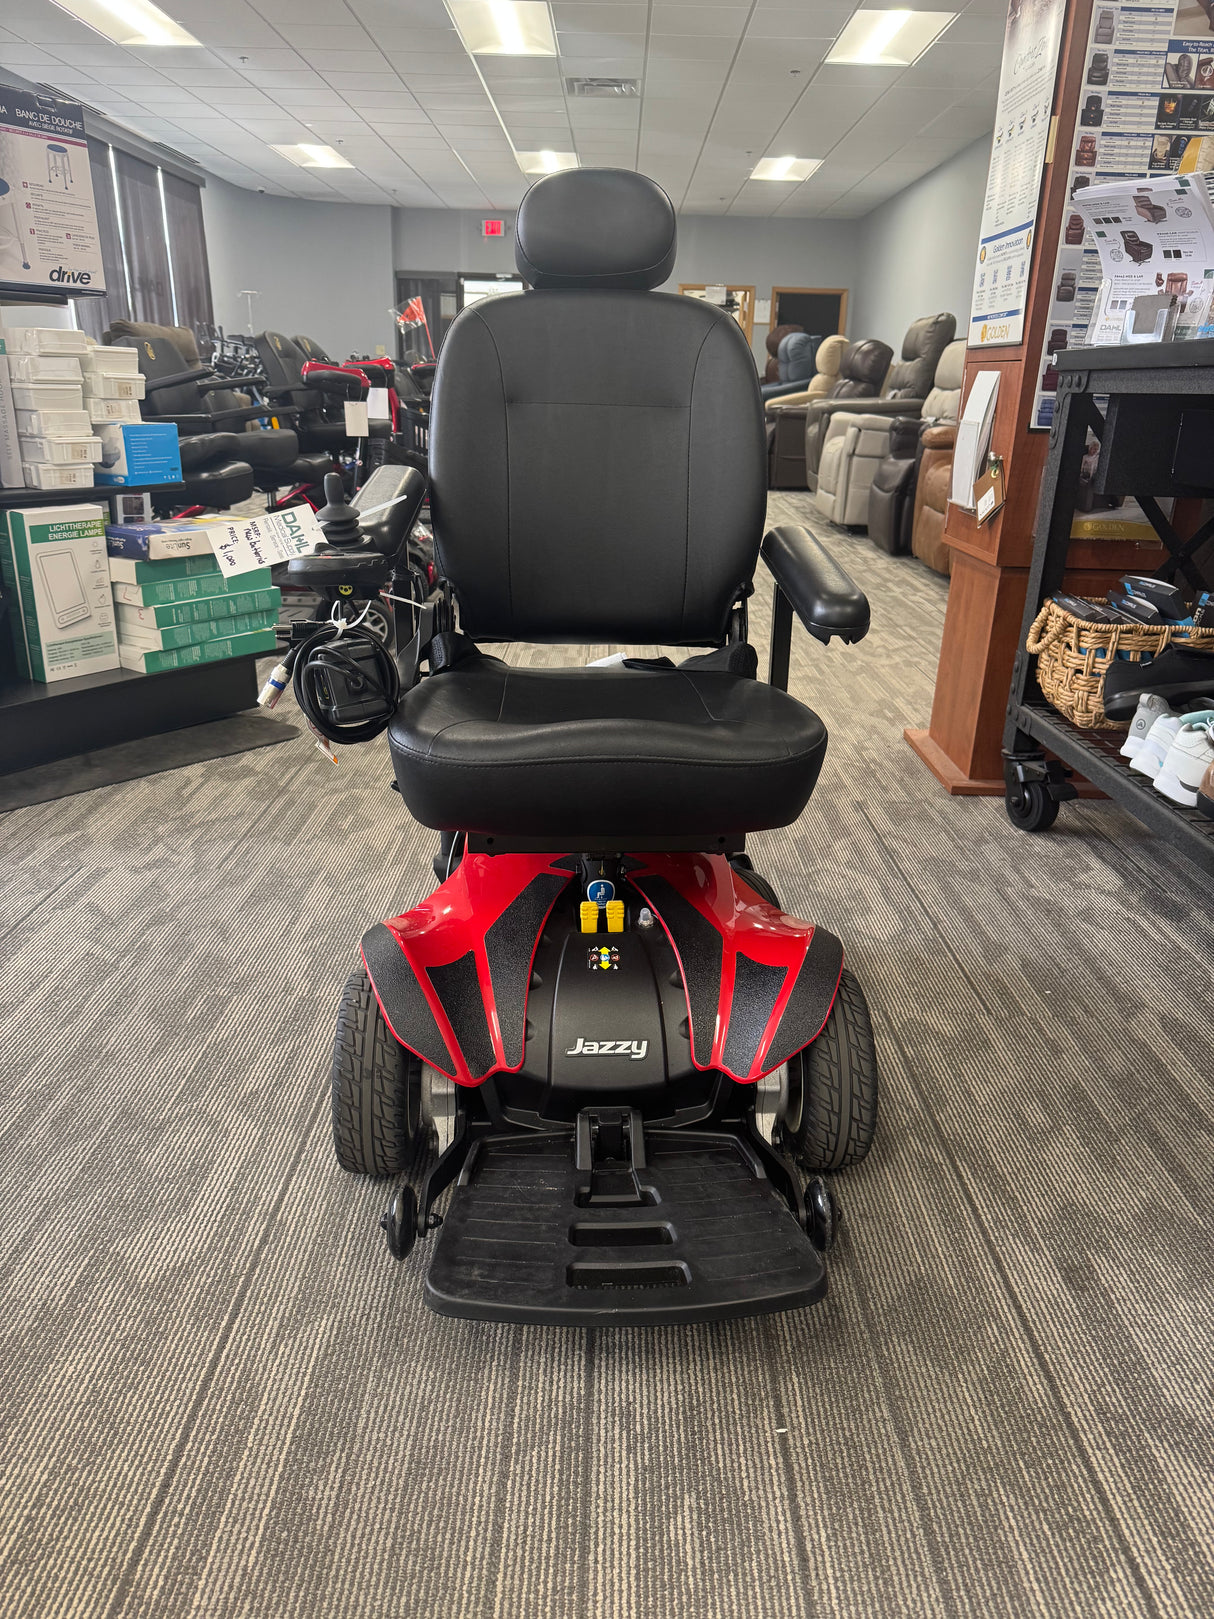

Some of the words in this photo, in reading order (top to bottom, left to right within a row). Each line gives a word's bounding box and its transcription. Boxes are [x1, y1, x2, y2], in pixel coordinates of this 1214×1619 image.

[15, 108, 38, 121] BANC
[39, 113, 51, 124] DE
[52, 115, 83, 131] DOUCHE
[28, 120, 41, 128] AVEC
[49, 266, 91, 285] drive
[987, 323, 1010, 341] GOLDEN
[48, 530, 79, 541] ENERGIE
[79, 528, 103, 537] LAMPE
[49, 520, 103, 532] LICHTTHERAPIE
[281, 511, 309, 553] DAHL
[566, 1038, 648, 1059] Jazzy
